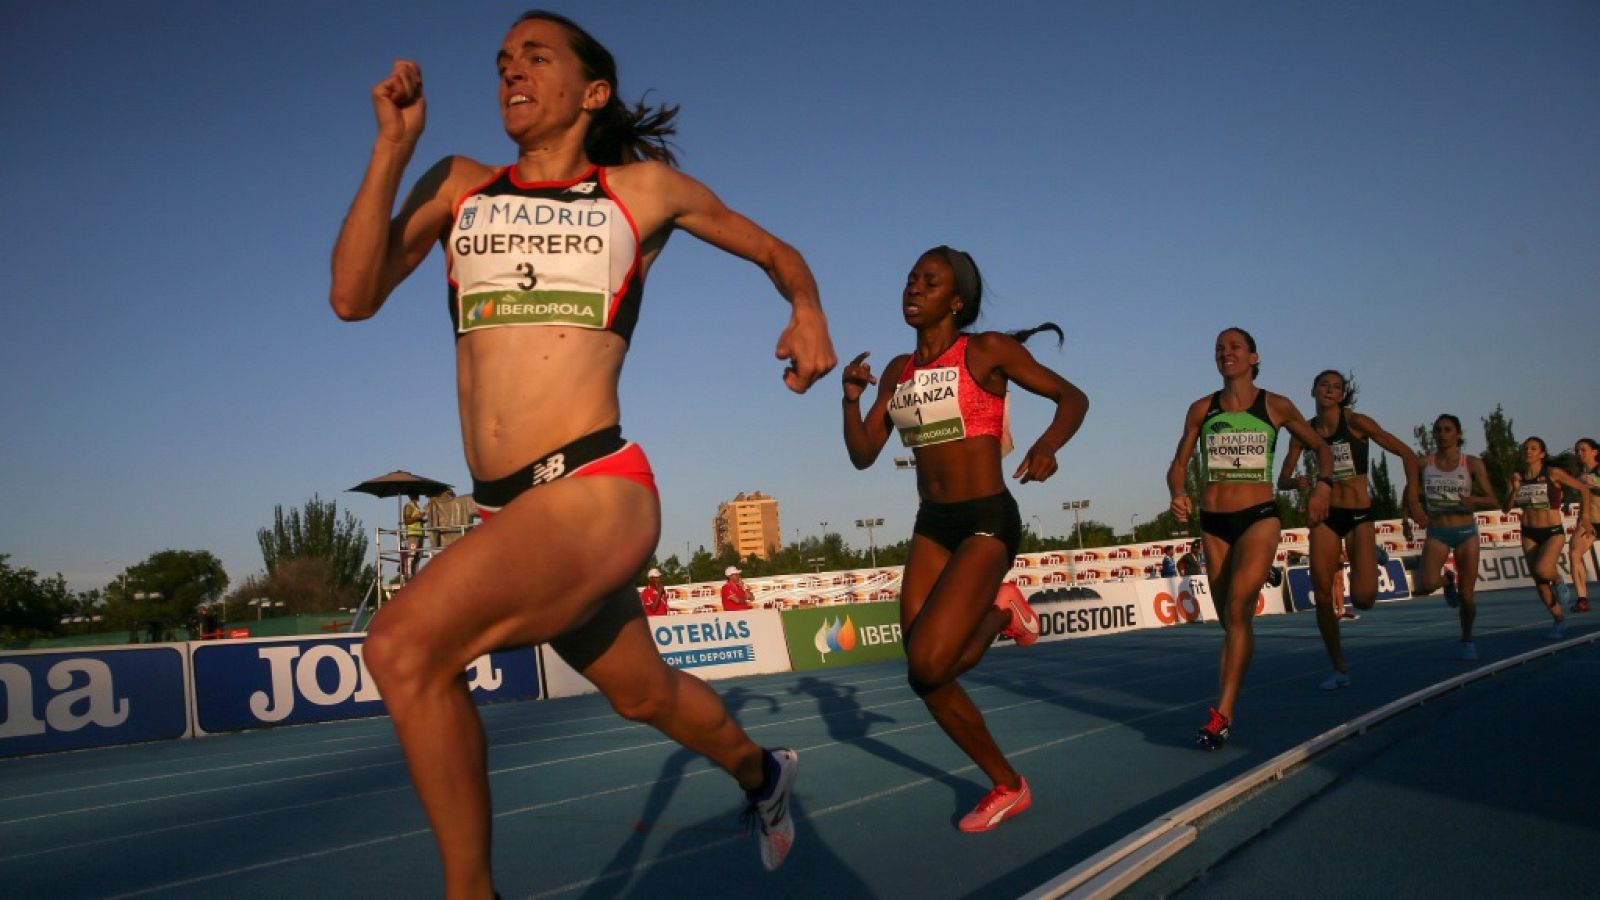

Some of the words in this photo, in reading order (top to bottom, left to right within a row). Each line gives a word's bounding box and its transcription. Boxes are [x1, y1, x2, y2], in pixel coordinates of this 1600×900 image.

[490, 203, 607, 227] MADRID
[455, 234, 604, 256] GUERRERO
[515, 261, 537, 291] 3
[496, 302, 595, 317] IBERDROLA
[909, 370, 957, 387] DRID
[890, 385, 955, 411] ALMANZA
[915, 407, 923, 426] 1
[918, 427, 960, 441] RDROLA
[1221, 434, 1266, 445] MADRID
[1209, 445, 1264, 456] ROMERO
[1232, 457, 1242, 469] 4
[1153, 591, 1200, 625] GO
[1190, 579, 1207, 594] fit
[1039, 604, 1136, 637] DGESTONE
[655, 617, 751, 646] OTERÍAS
[686, 655, 698, 664] EL
[699, 649, 743, 662] DEPORTE
